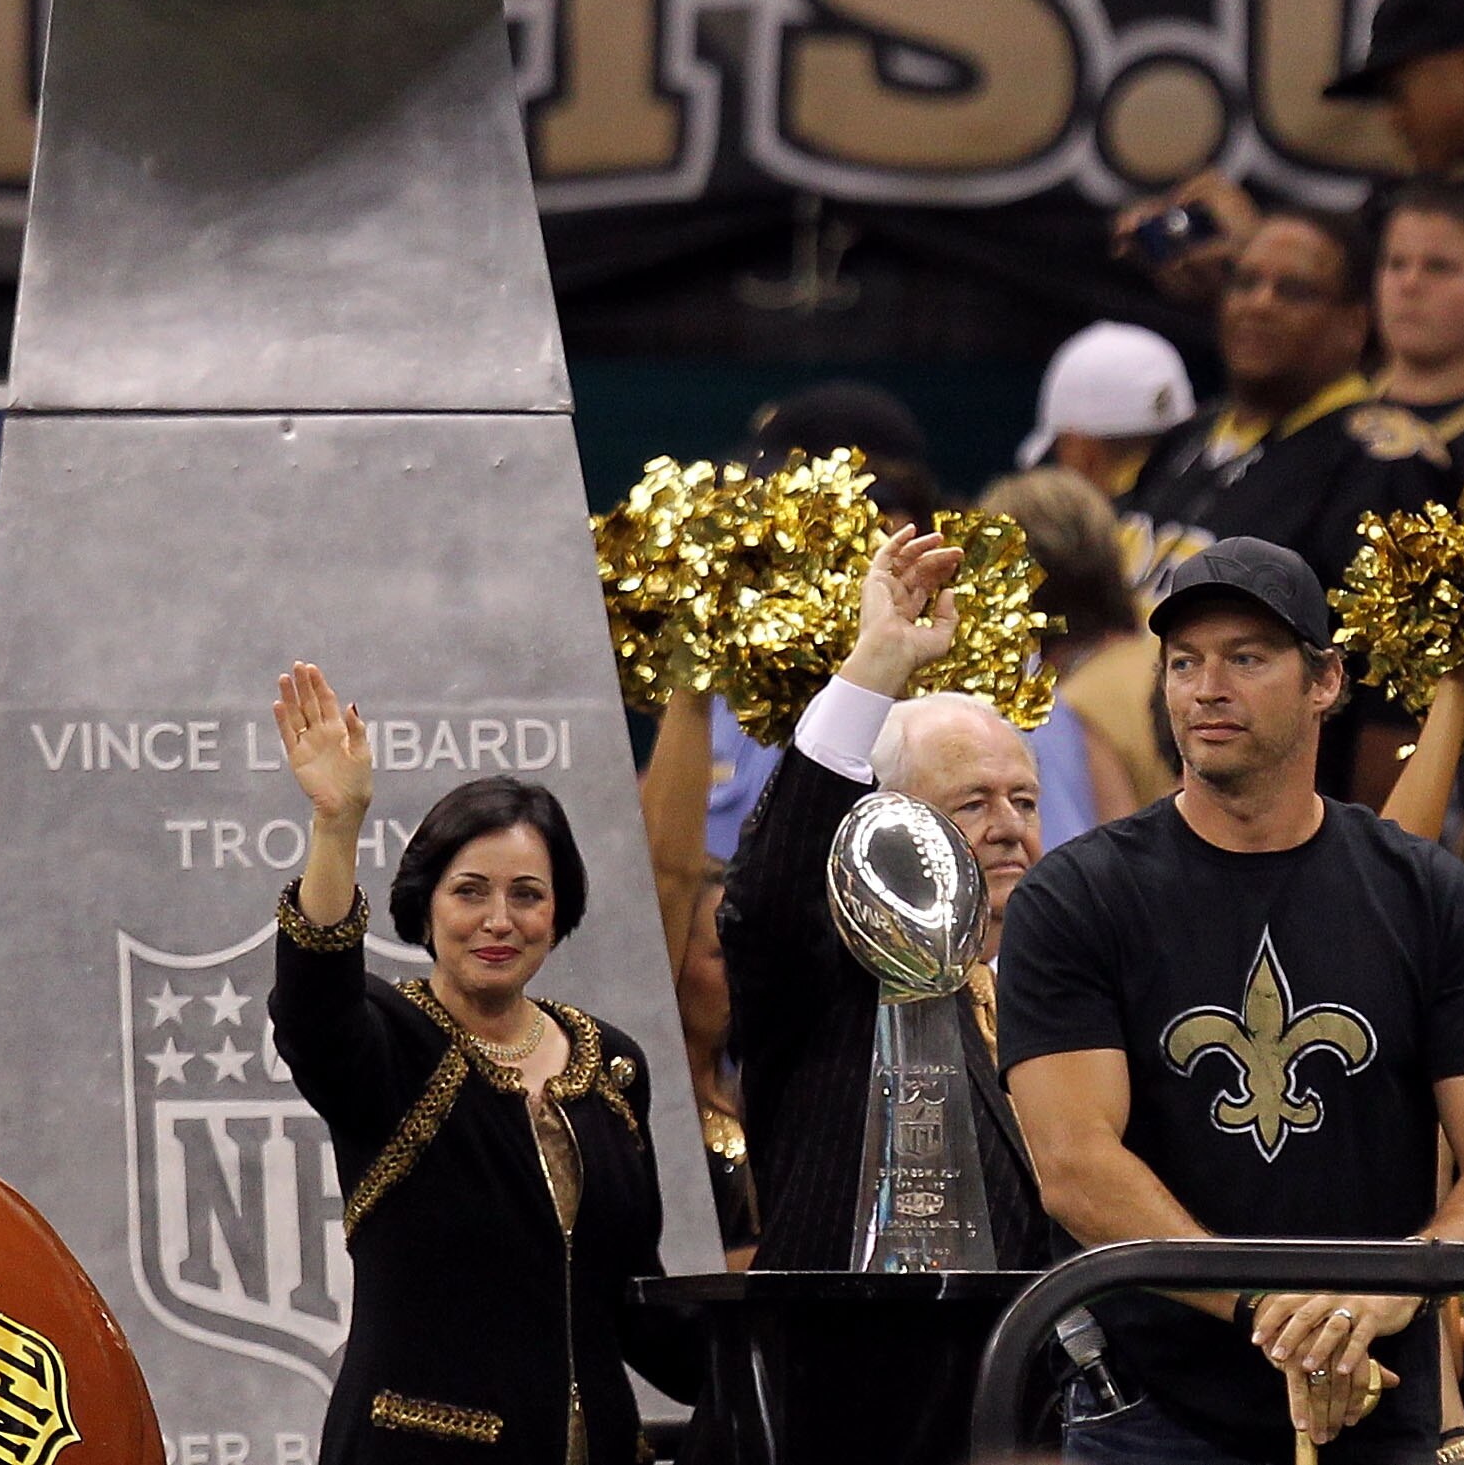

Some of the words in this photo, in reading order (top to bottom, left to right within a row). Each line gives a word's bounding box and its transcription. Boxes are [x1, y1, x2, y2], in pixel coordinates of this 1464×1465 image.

[30, 719, 222, 772] VINCE
[246, 719, 573, 772] LBARDI
[165, 818, 415, 871] TROH
